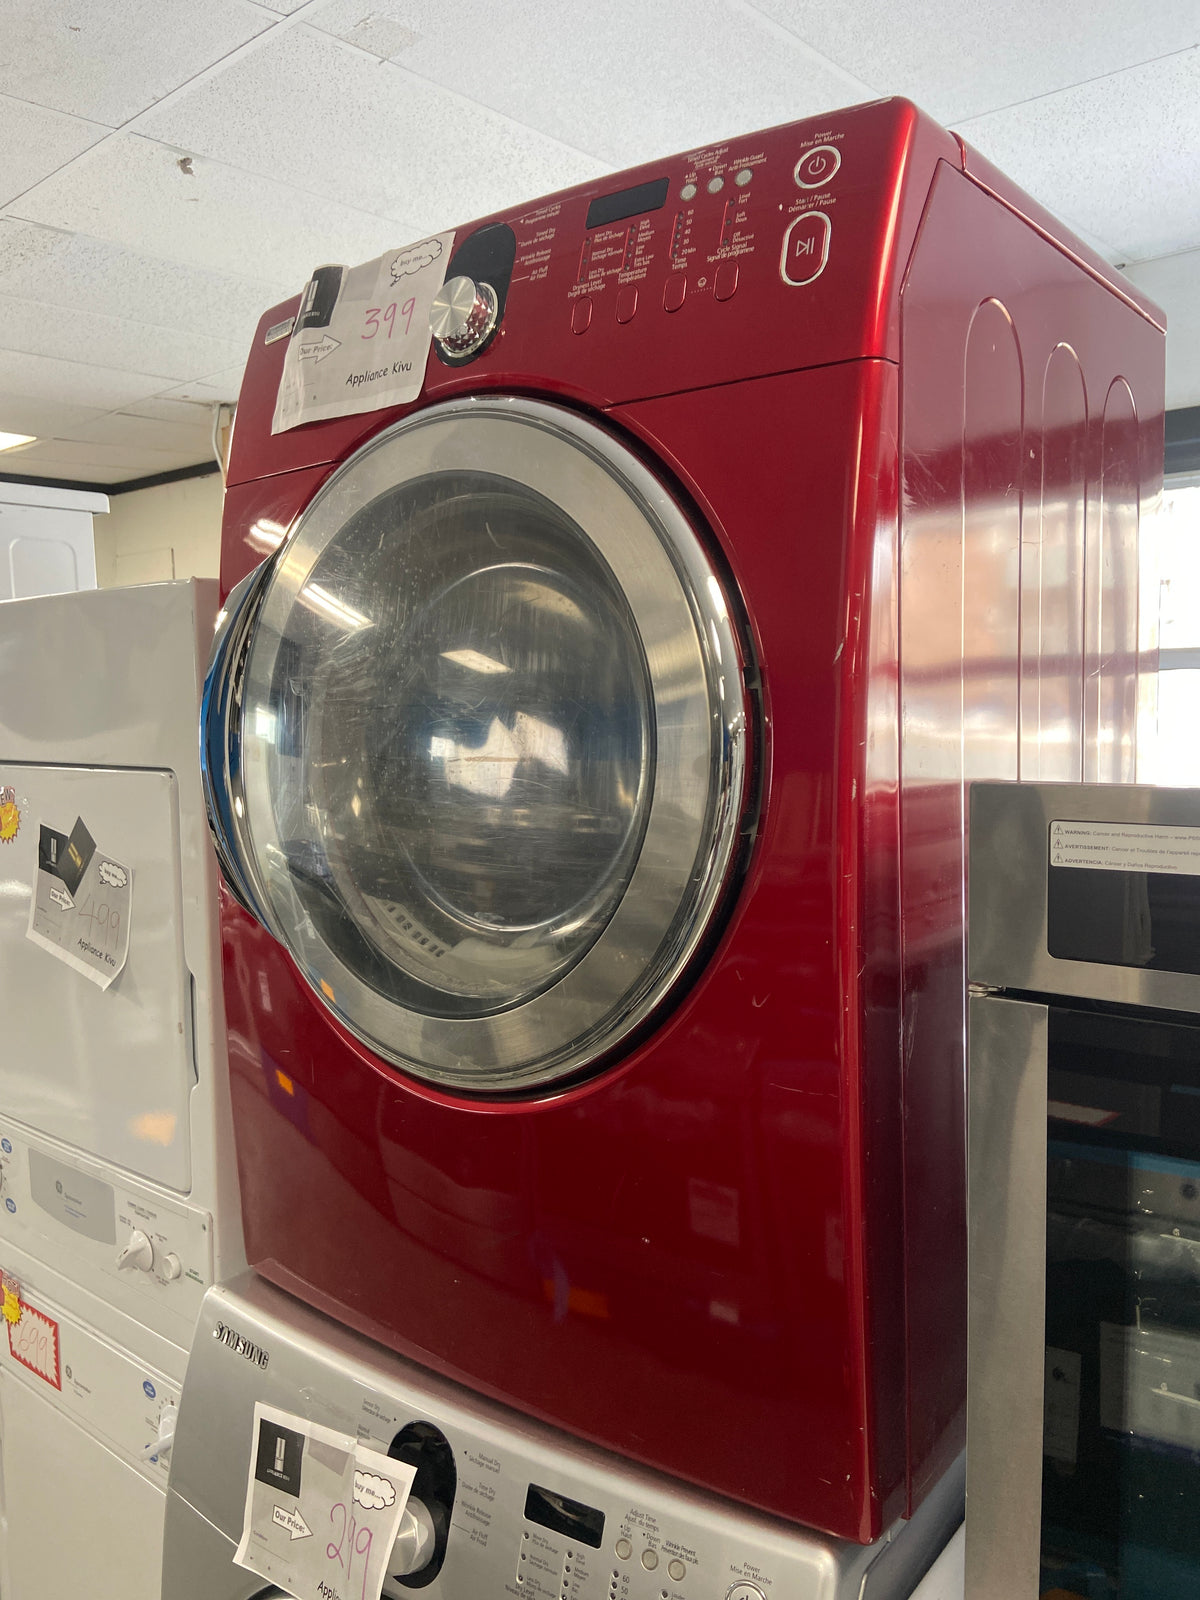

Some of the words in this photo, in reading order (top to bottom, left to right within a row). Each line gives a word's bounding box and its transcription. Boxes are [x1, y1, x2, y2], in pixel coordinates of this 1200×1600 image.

[800, 140, 814, 148] Mise
[823, 133, 845, 143] Marche
[814, 131, 833, 139] Power
[749, 152, 765, 161] Guard
[712, 163, 728, 172] Down
[689, 171, 697, 179] Up
[739, 192, 751, 200] Loud
[813, 192, 831, 202] Pause
[820, 198, 837, 206] Pause
[717, 246, 731, 256] Cycle
[731, 241, 748, 251] Signal
[674, 257, 687, 265] Time
[706, 254, 721, 263] Signal
[672, 262, 688, 271] Temps
[618, 267, 648, 278] Temperature
[590, 277, 603, 286] Level
[361, 297, 417, 340] 399
[346, 367, 389, 386] Appliance
[392, 361, 413, 378] Kivu
[78, 893, 121, 950] 499
[77, 938, 104, 960] Appliance
[105, 952, 117, 968] Kivu
[18, 1320, 48, 1374] 699
[212, 1321, 269, 1369] SAMSUNG
[630, 1508, 645, 1520] Adjust
[645, 1513, 657, 1523] Time
[275, 1509, 287, 1523] Our
[287, 1515, 306, 1534] Price:
[638, 1518, 645, 1527] du
[645, 1522, 660, 1533] temps
[624, 1524, 632, 1533] Up
[620, 1531, 633, 1540] Haut
[646, 1532, 661, 1544] Down
[648, 1540, 657, 1550] Bas
[665, 1540, 681, 1551] Wrinkle
[680, 1546, 697, 1558] Prevent
[743, 1561, 761, 1574] Power
[622, 1574, 631, 1585] 60
[730, 1564, 743, 1576] Mise
[743, 1570, 751, 1578] en
[751, 1572, 773, 1586] Marche
[515, 1583, 524, 1592] Dry
[523, 1587, 536, 1598] Level
[620, 1586, 629, 1596] 50
